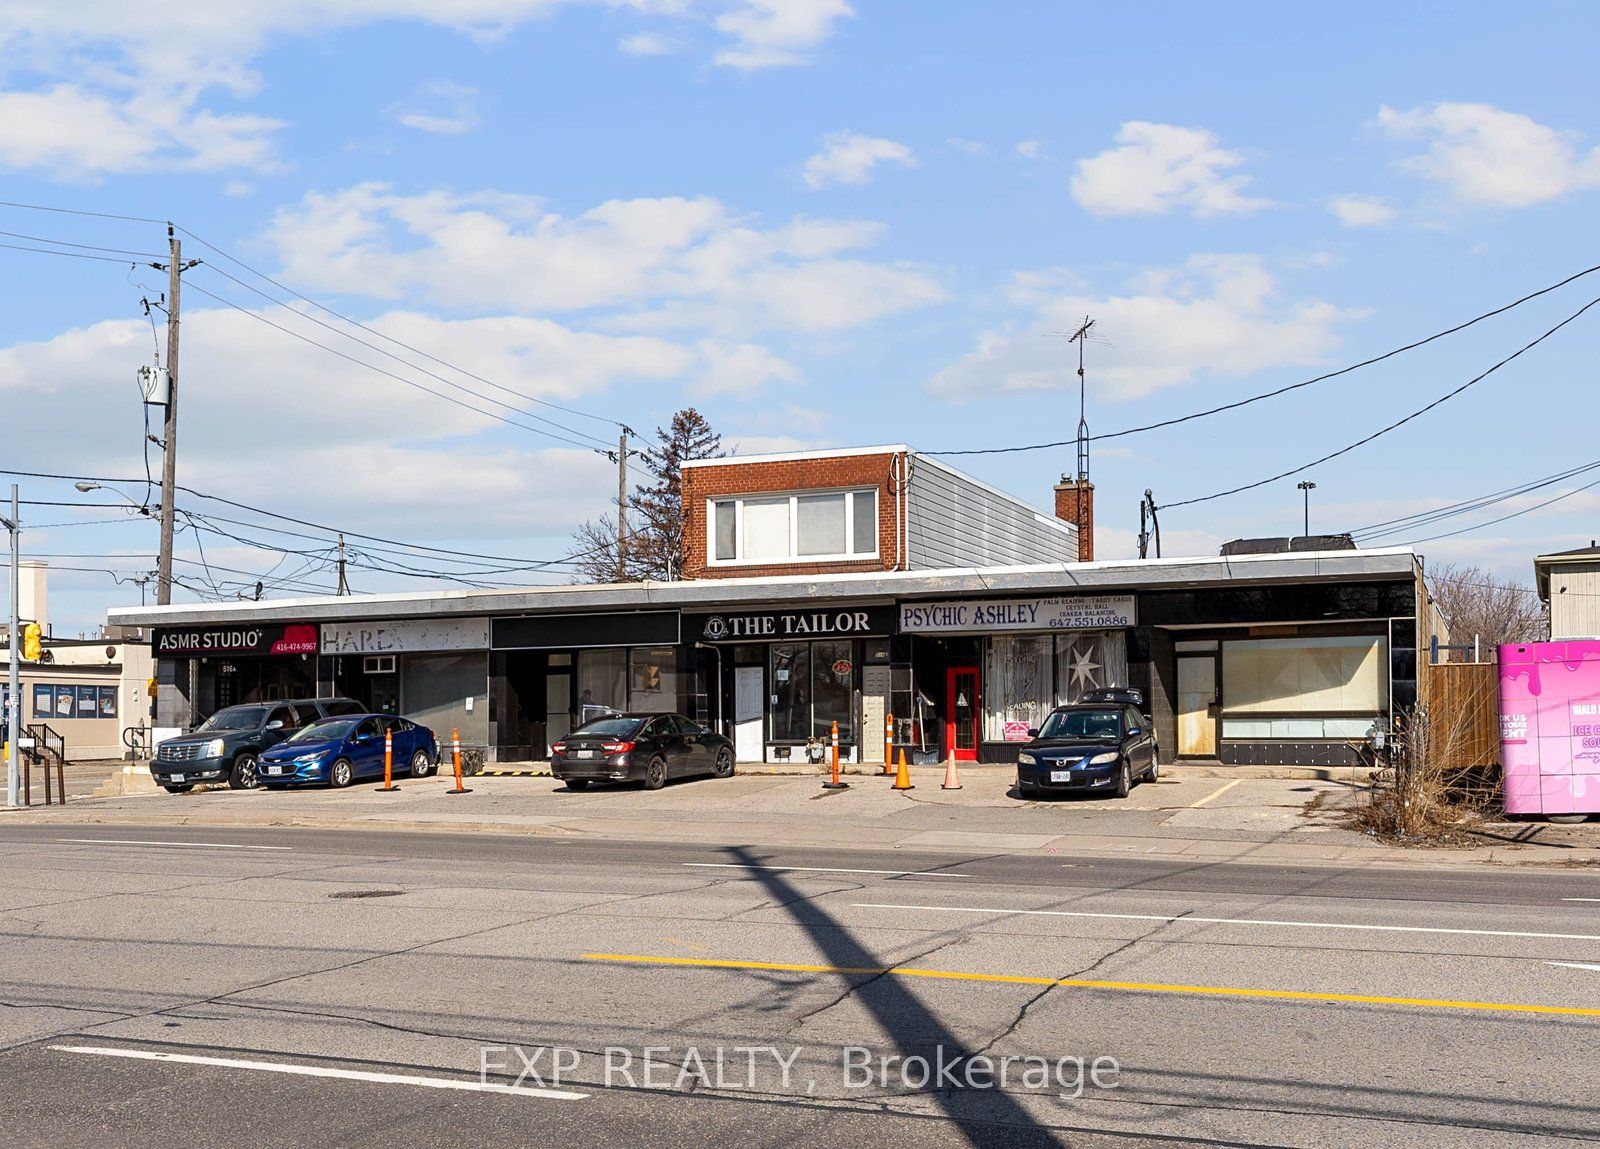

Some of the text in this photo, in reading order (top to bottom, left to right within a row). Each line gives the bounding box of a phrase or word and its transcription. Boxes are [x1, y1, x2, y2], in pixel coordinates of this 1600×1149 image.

[903, 600, 1040, 627] PSYCHIC ASHLEY
[729, 617, 775, 635] THE
[781, 612, 871, 634] TAILOR
[1049, 616, 1128, 627] 647.551.0886
[159, 631, 258, 650] ASMR STUDIO
[276, 642, 317, 651] 416-474-9967
[1513, 713, 1527, 722] US
[1503, 721, 1527, 729] YOUR
[1573, 725, 1591, 736] ICE
